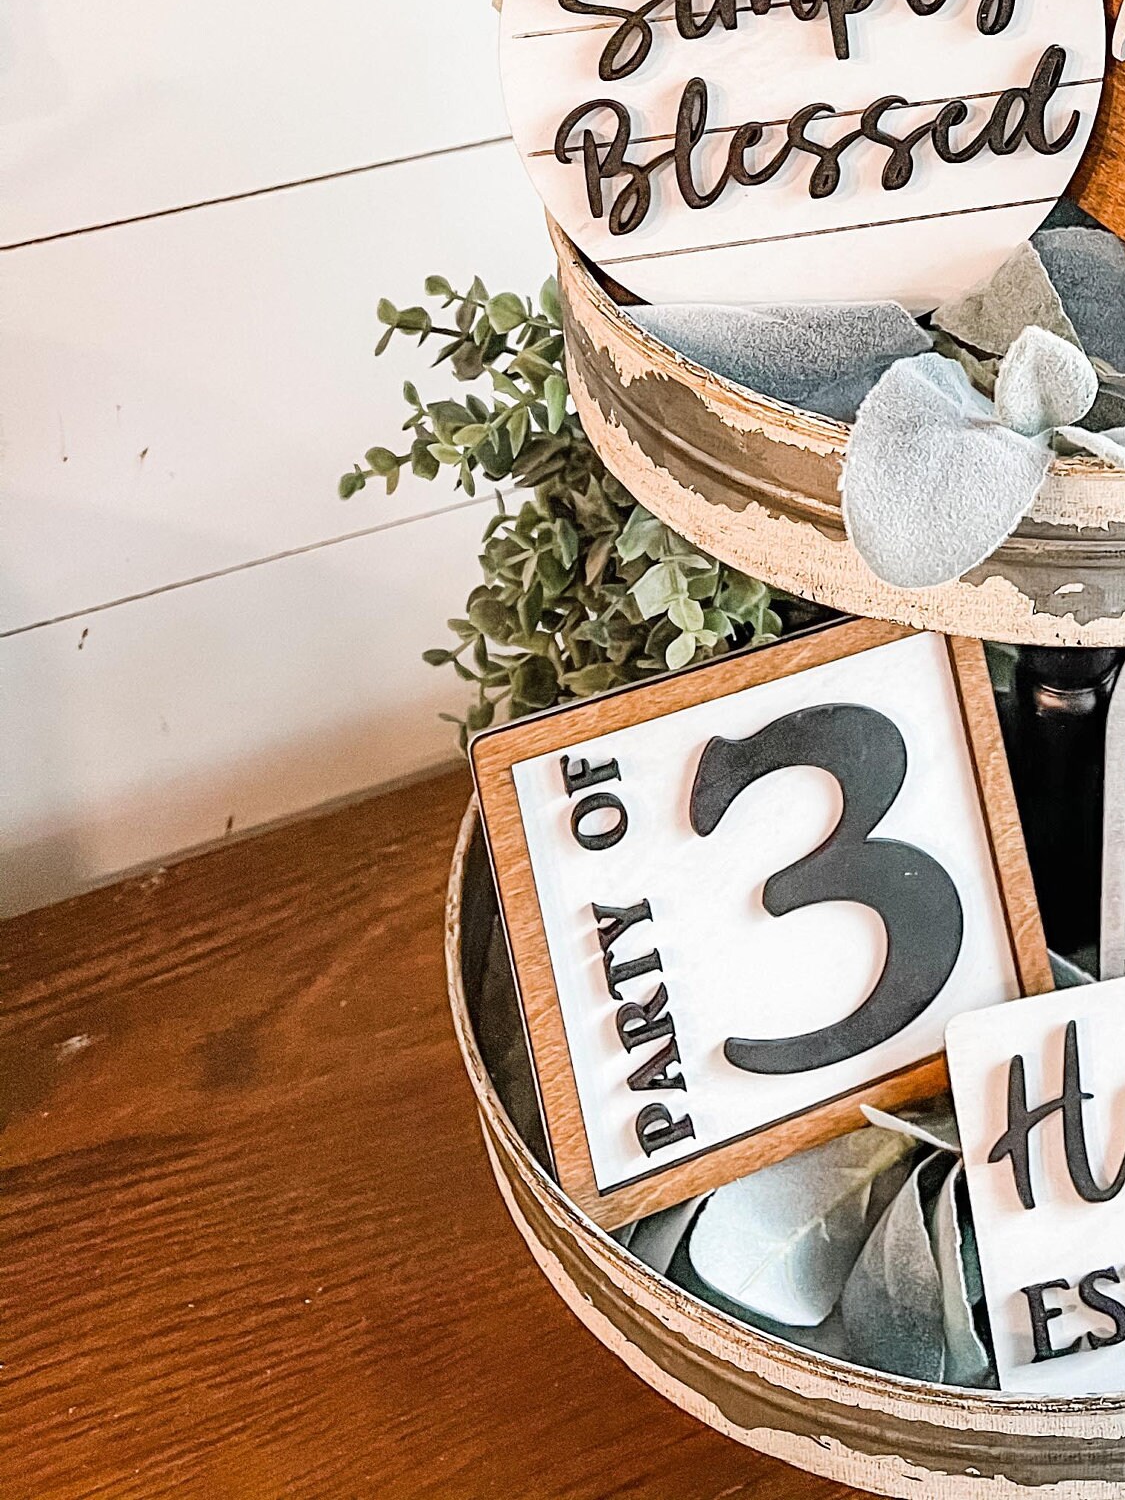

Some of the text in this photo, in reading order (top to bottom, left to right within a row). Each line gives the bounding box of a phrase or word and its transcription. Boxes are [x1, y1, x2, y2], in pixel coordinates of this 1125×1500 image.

[554, 44, 1081, 236] Blessed
[560, 754, 697, 1158] PARTY OF
[690, 702, 964, 1075] 3
